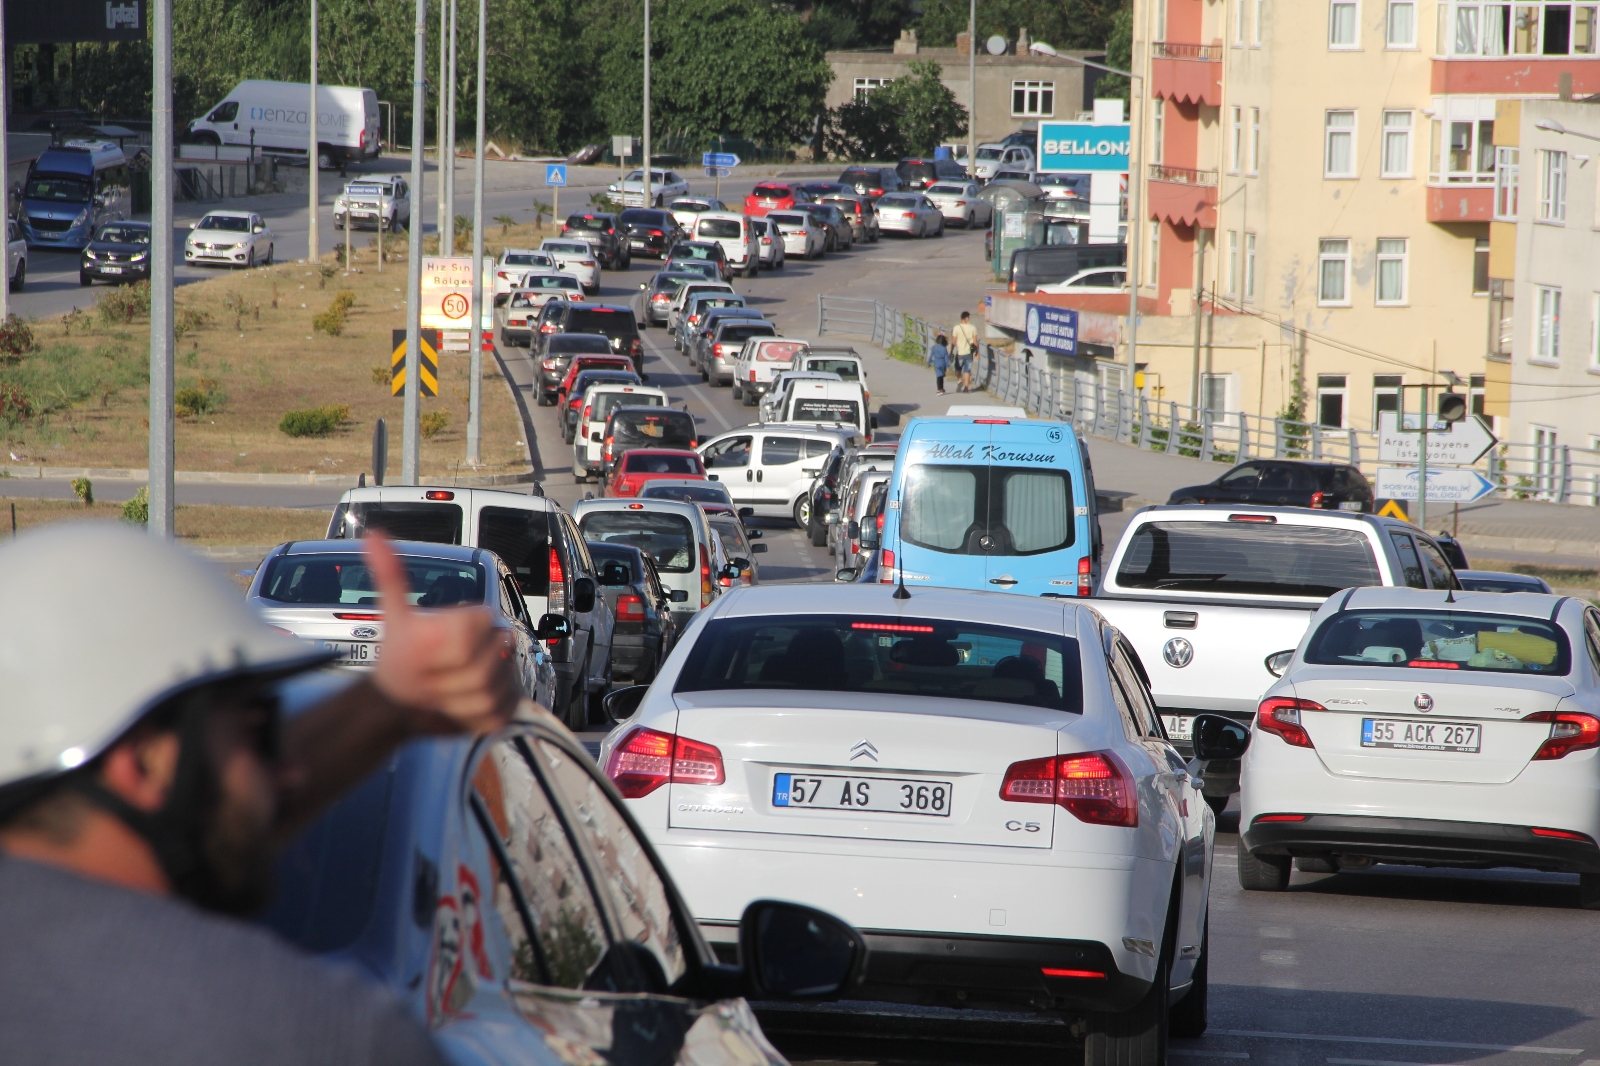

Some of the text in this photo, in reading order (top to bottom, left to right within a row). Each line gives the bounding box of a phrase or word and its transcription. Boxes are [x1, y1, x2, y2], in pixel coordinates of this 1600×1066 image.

[264, 108, 307, 125] enza
[317, 112, 350, 128] OME
[434, 276, 473, 287] Bölges
[447, 299, 464, 313] 50
[1050, 431, 1060, 440] 45
[1385, 438, 1410, 447] Araç
[923, 443, 1056, 463] Allah Korusun
[350, 644, 368, 659] HG
[1169, 717, 1188, 733] AE
[1374, 722, 1476, 745] 55 ACK 267
[776, 792, 788, 801] TR
[792, 779, 946, 811] 57 AS 368
[1004, 820, 1041, 833] C5
